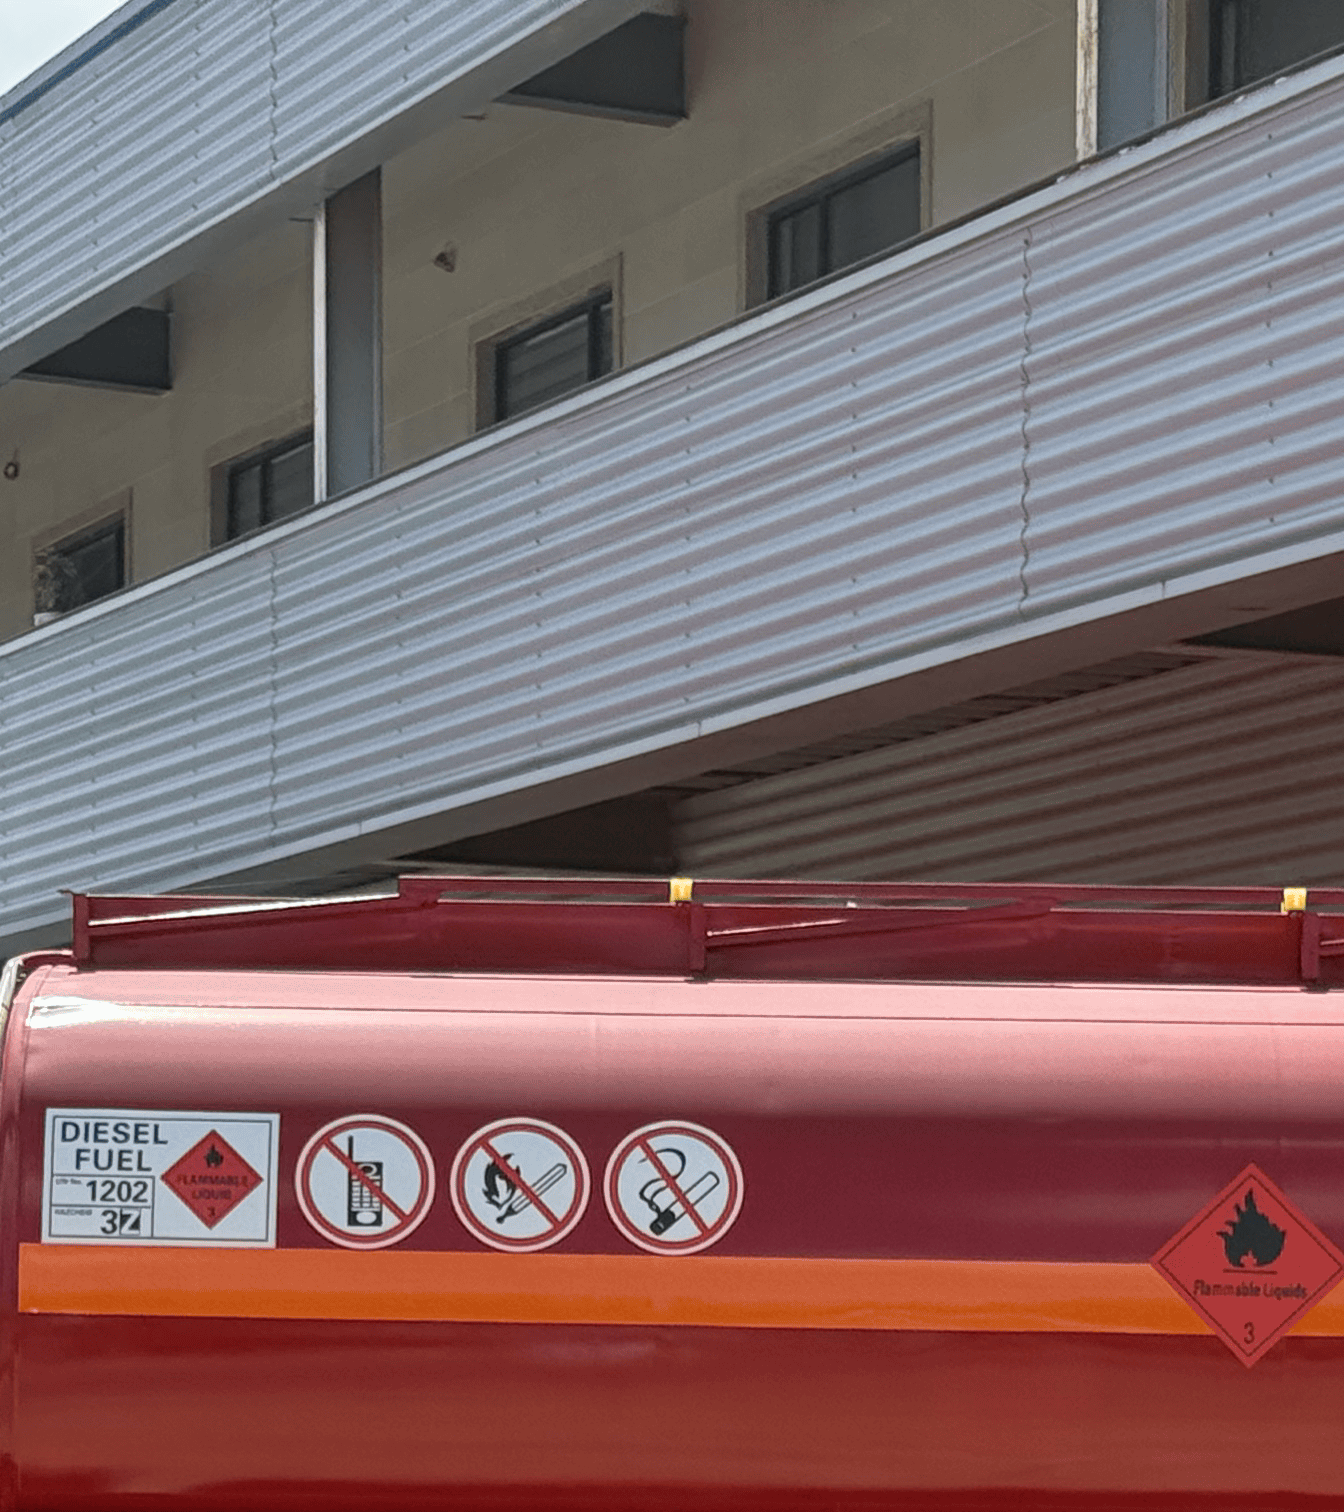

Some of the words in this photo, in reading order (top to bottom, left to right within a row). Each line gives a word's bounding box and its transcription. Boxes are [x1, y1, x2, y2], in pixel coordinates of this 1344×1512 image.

[60, 1121, 169, 1145] DIESEL
[74, 1148, 153, 1172] FUEL
[86, 1179, 149, 1203] 1202
[1194, 1280, 1260, 1296] Flammable
[1244, 1322, 1255, 1344] 3
